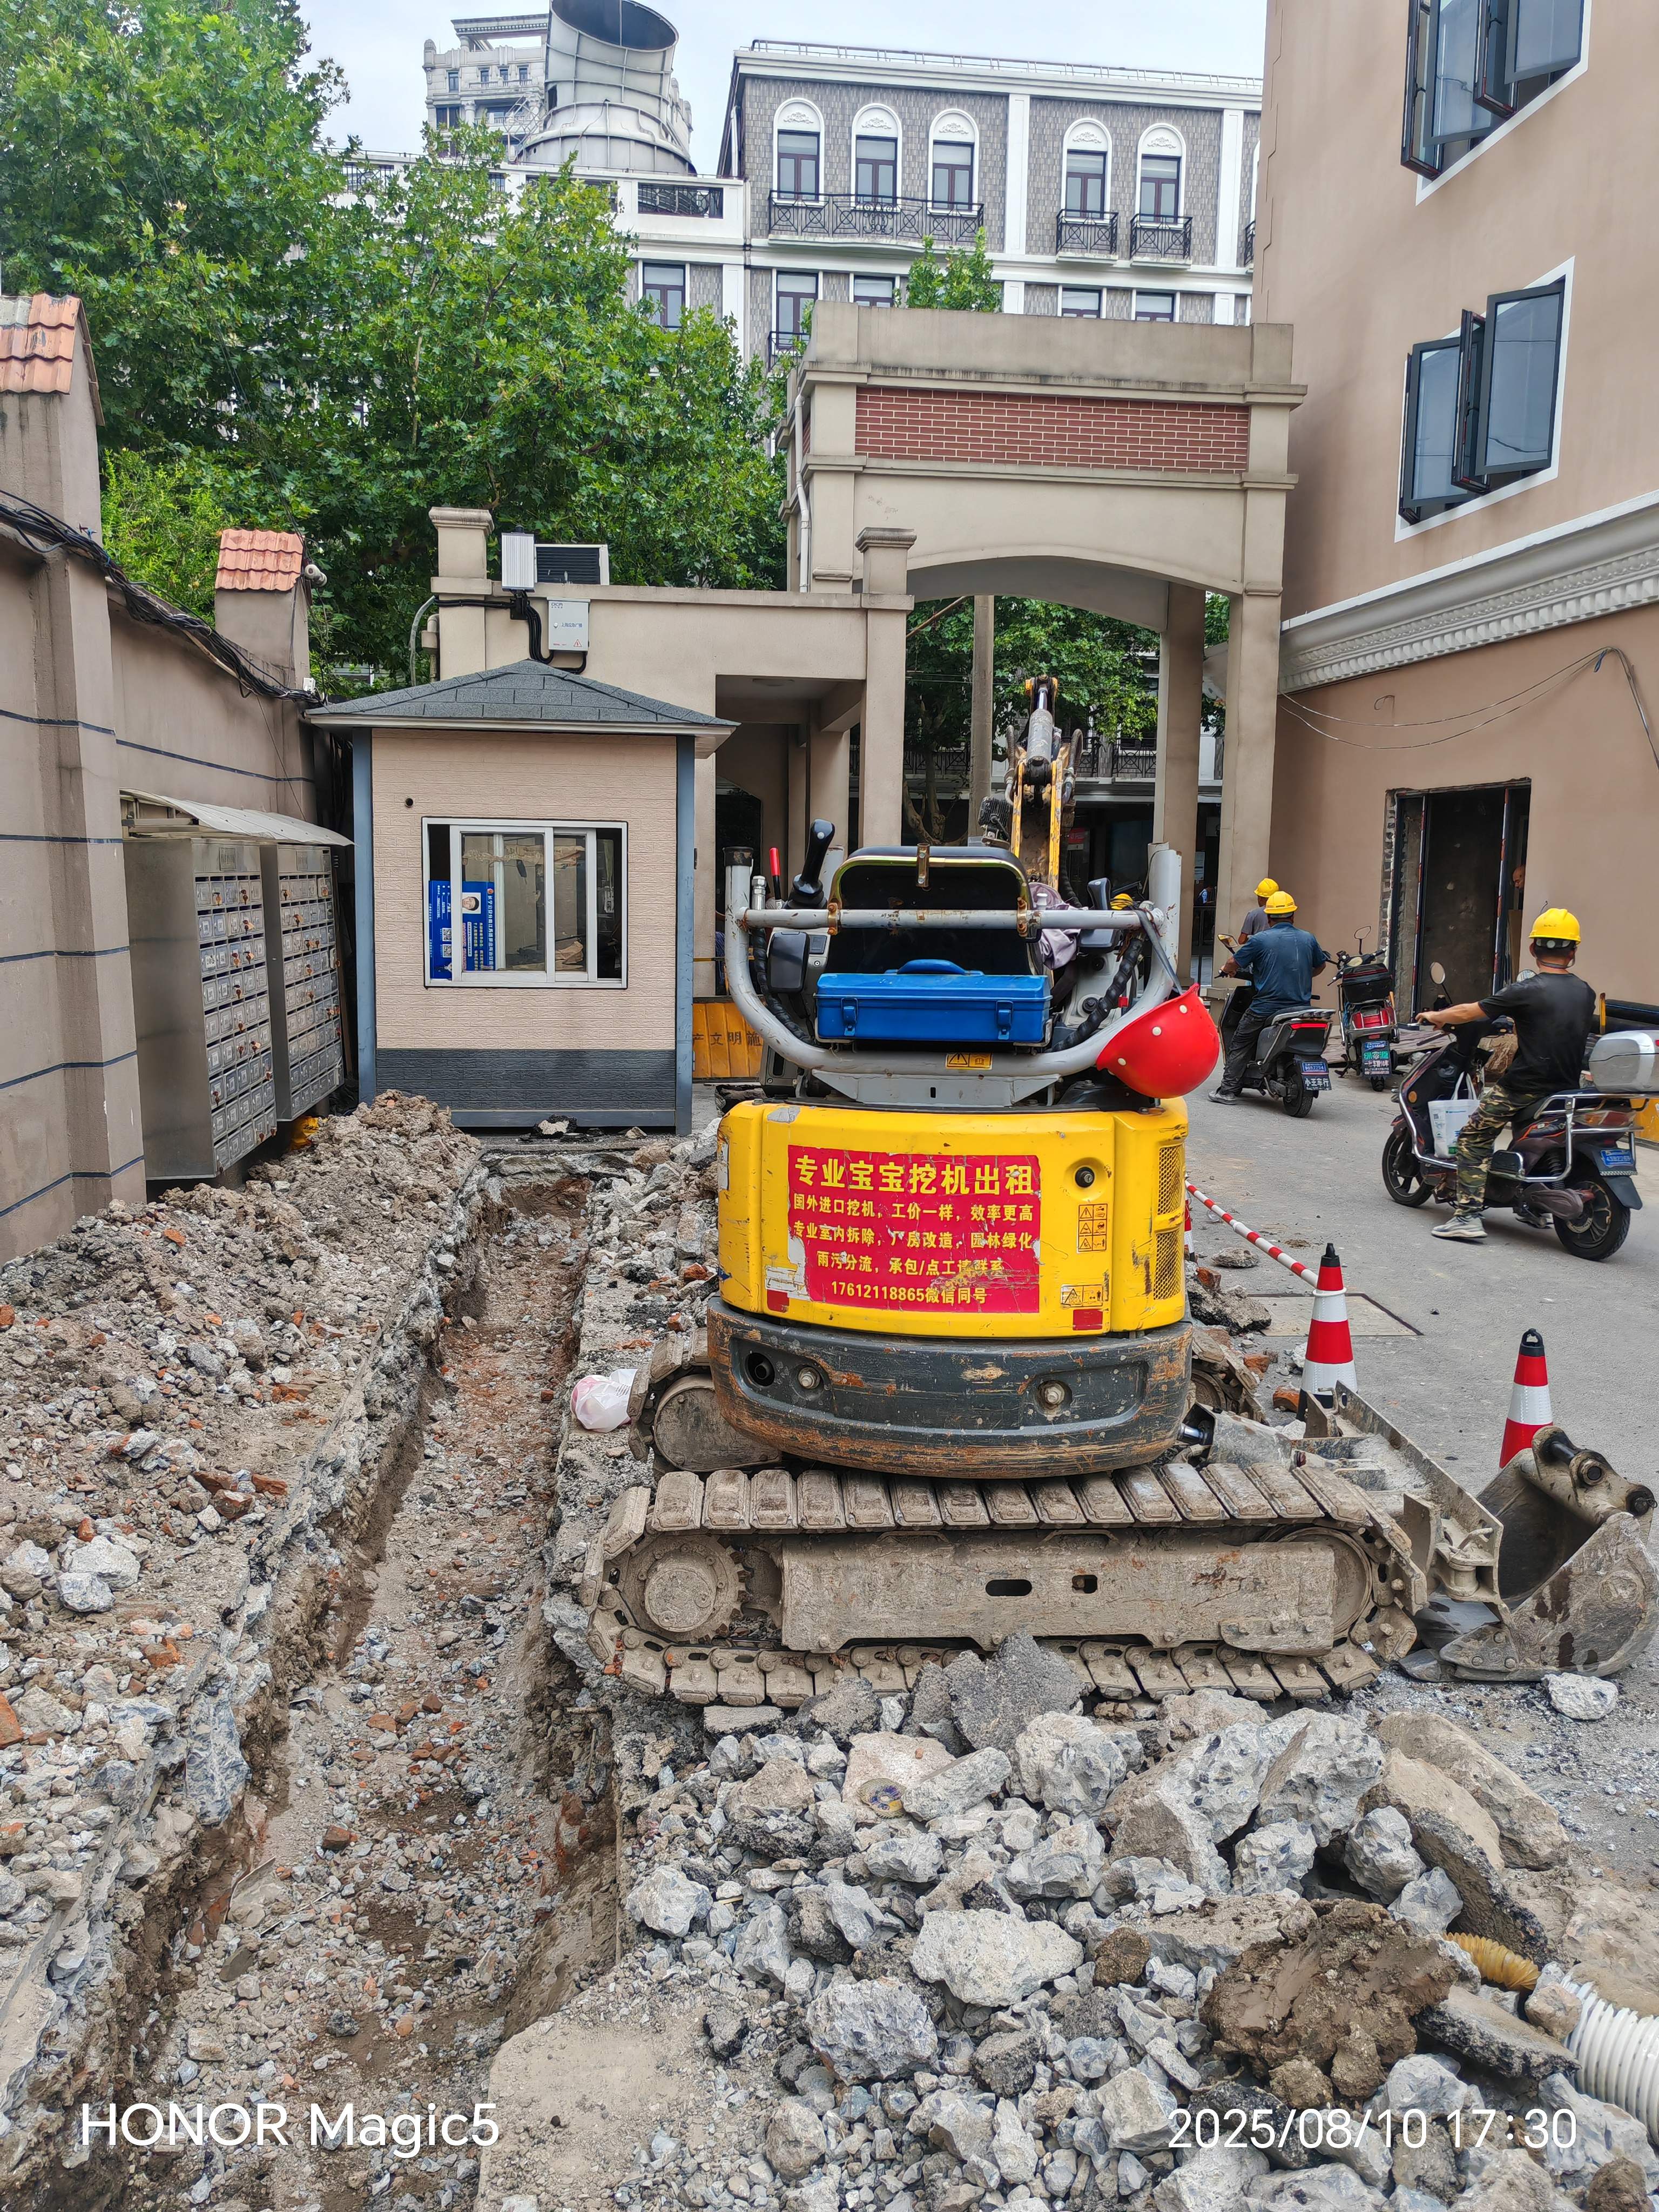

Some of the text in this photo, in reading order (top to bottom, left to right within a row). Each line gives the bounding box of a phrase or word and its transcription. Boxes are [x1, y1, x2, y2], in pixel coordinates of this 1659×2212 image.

[794, 1155, 1034, 1195] 专业宝宝挖机出租
